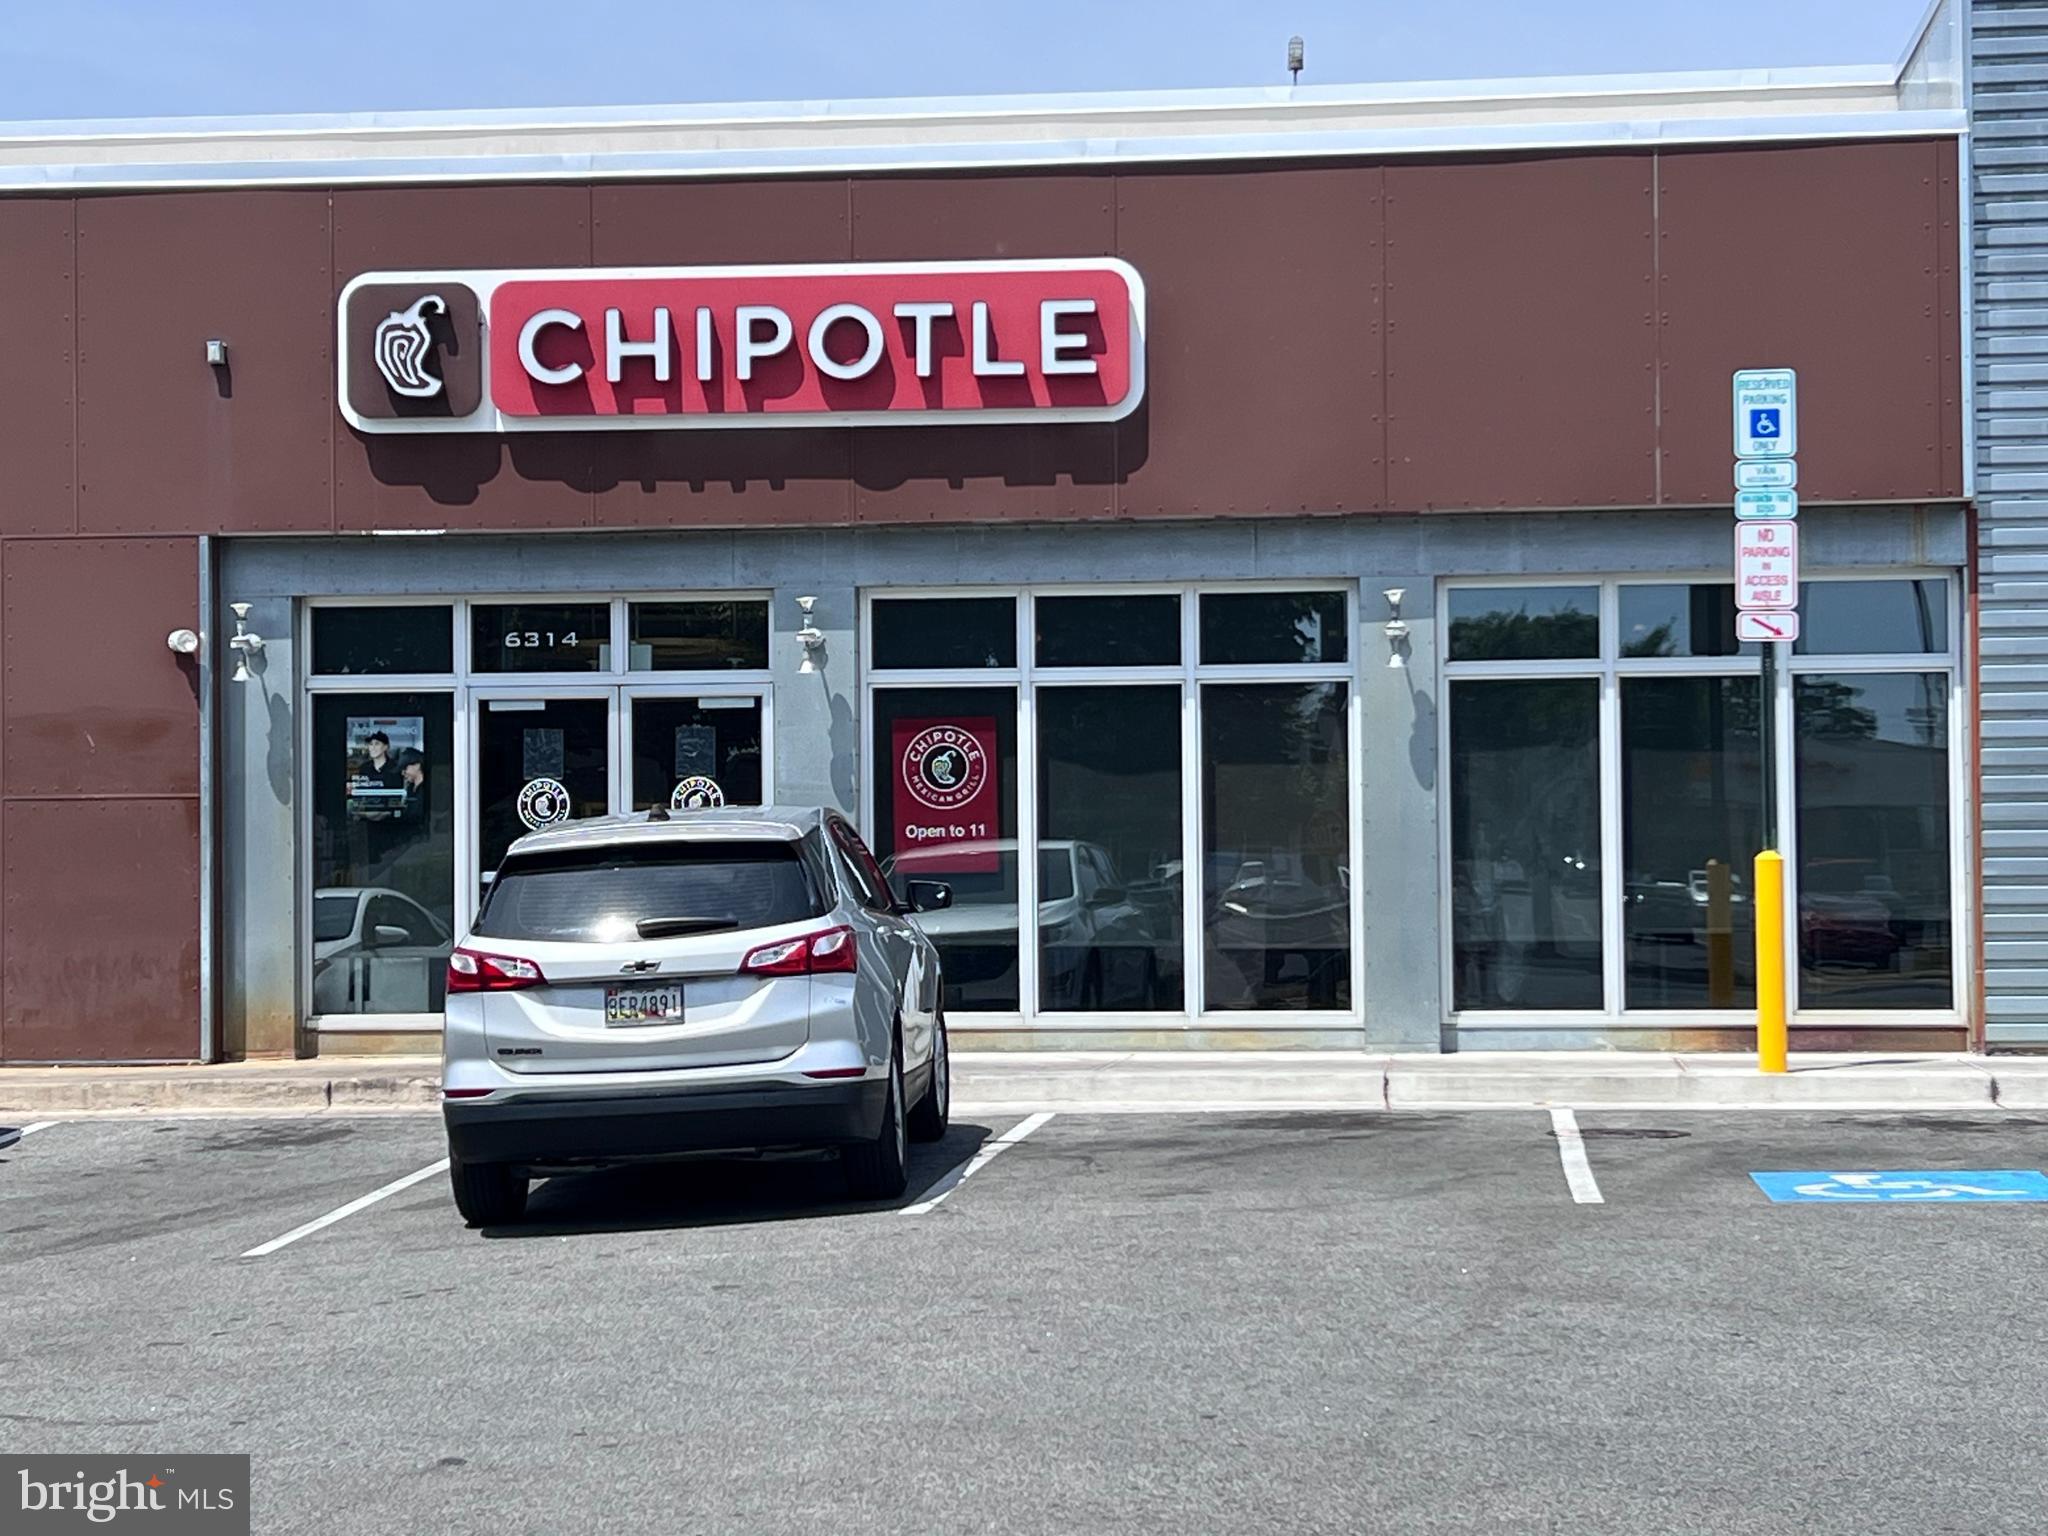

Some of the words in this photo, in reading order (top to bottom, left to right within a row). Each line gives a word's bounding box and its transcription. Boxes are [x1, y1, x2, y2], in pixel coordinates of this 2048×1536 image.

[517, 299, 1098, 386] CHIPOTLE
[1743, 394, 1787, 404] PARKING
[1758, 528, 1774, 542] NO
[1743, 547, 1790, 557] PARKING
[1745, 575, 1788, 586] ACCESS
[1752, 590, 1781, 601] AISLE
[505, 632, 579, 647] 6314
[910, 731, 980, 761] CHIPOTLE
[911, 775, 953, 802] MEXICAN
[955, 774, 979, 799] GRILL
[905, 825, 945, 841] Open
[949, 825, 965, 837] to
[970, 824, 985, 836] 11
